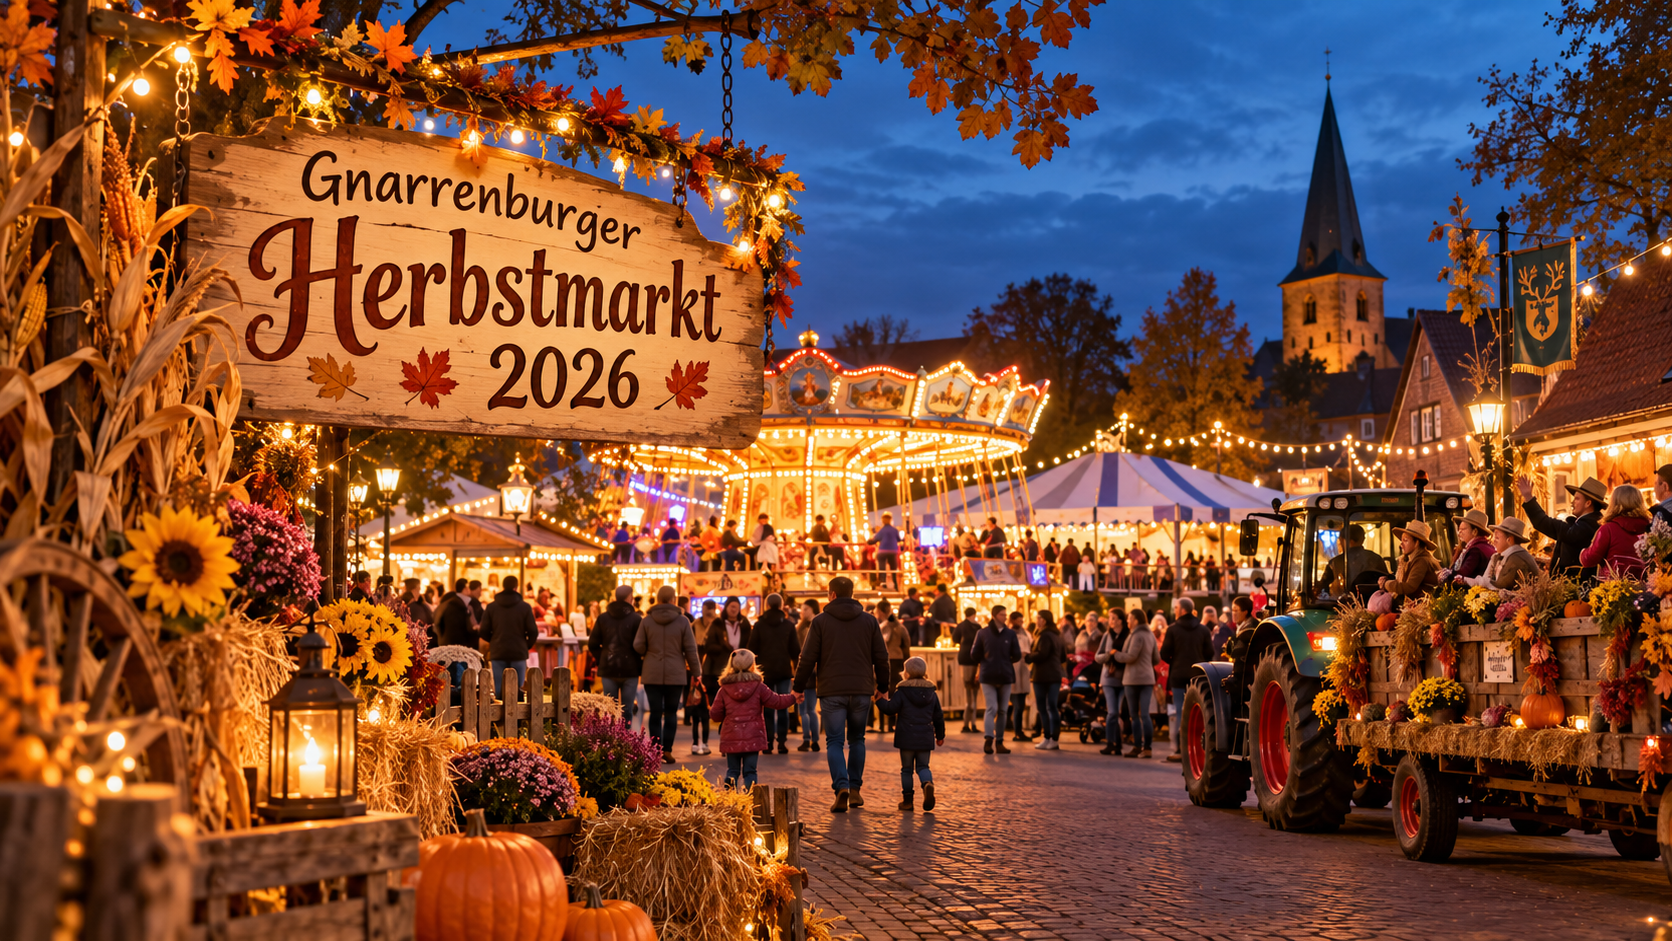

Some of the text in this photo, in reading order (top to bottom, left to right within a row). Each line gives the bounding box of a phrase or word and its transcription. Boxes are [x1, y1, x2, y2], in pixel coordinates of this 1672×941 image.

[301, 150, 641, 252] Gnarrenburger
[245, 215, 722, 361] Herbstmarkt
[487, 343, 639, 410] 2026
